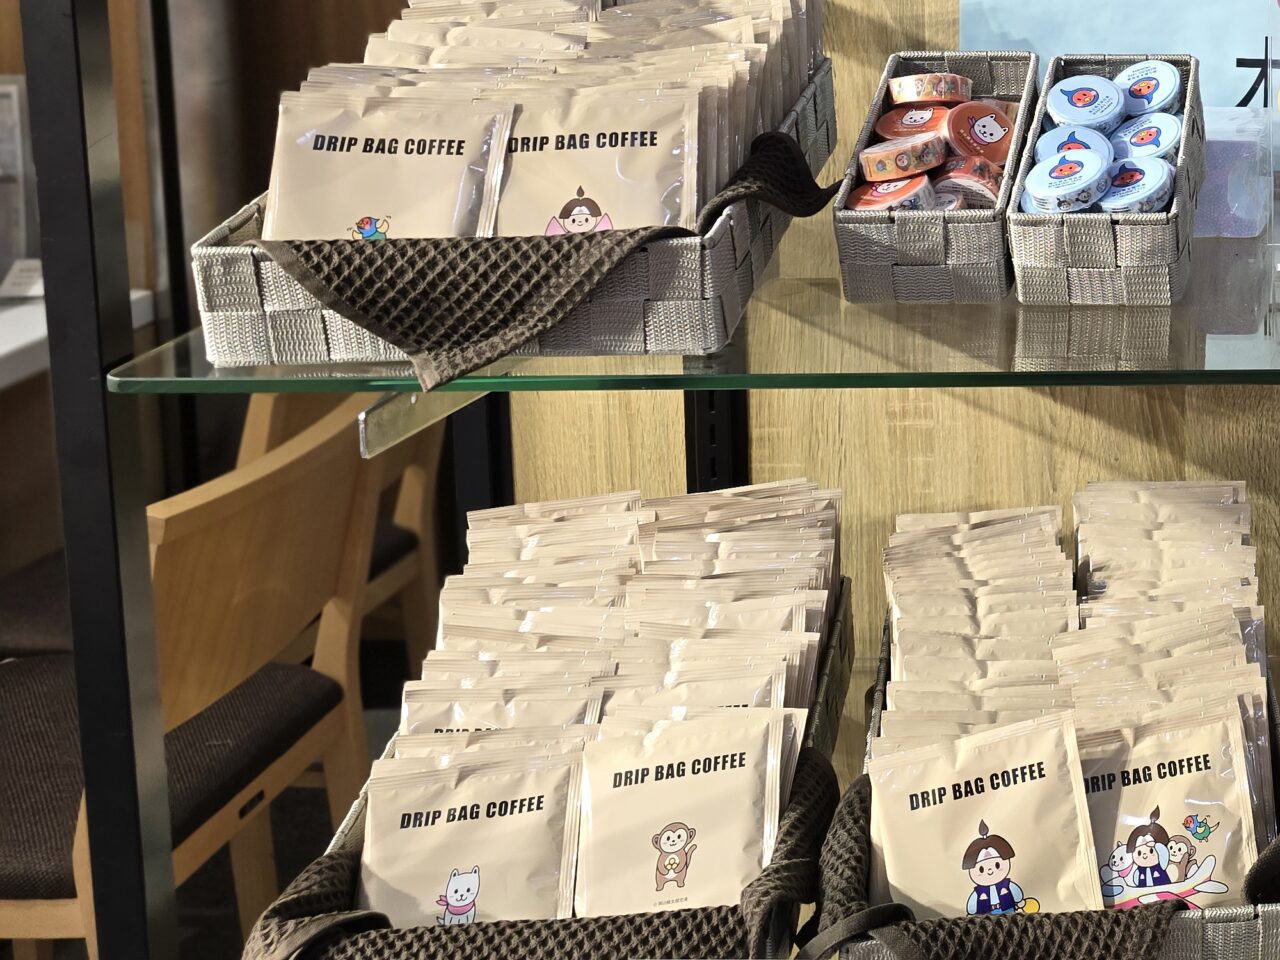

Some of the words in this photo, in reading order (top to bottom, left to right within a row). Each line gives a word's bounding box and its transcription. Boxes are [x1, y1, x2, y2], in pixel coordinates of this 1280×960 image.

[312, 134, 358, 153] DRIP
[362, 136, 399, 155] BAG
[403, 138, 466, 157] COFFEE
[507, 135, 550, 154] DRIP
[554, 132, 591, 152] BAG
[595, 130, 659, 150] COFFEE
[612, 766, 650, 789] DRIP
[654, 760, 687, 782] BAG
[691, 751, 747, 776] COFFEE
[909, 786, 947, 811] DRIP
[952, 773, 986, 801] BAG
[990, 760, 1047, 791] COFFEE
[1121, 765, 1152, 788] BAG
[1157, 753, 1212, 782] COFFEE
[400, 808, 442, 830] DRIP
[446, 802, 480, 824] BAG
[485, 794, 545, 819] COFFEE
